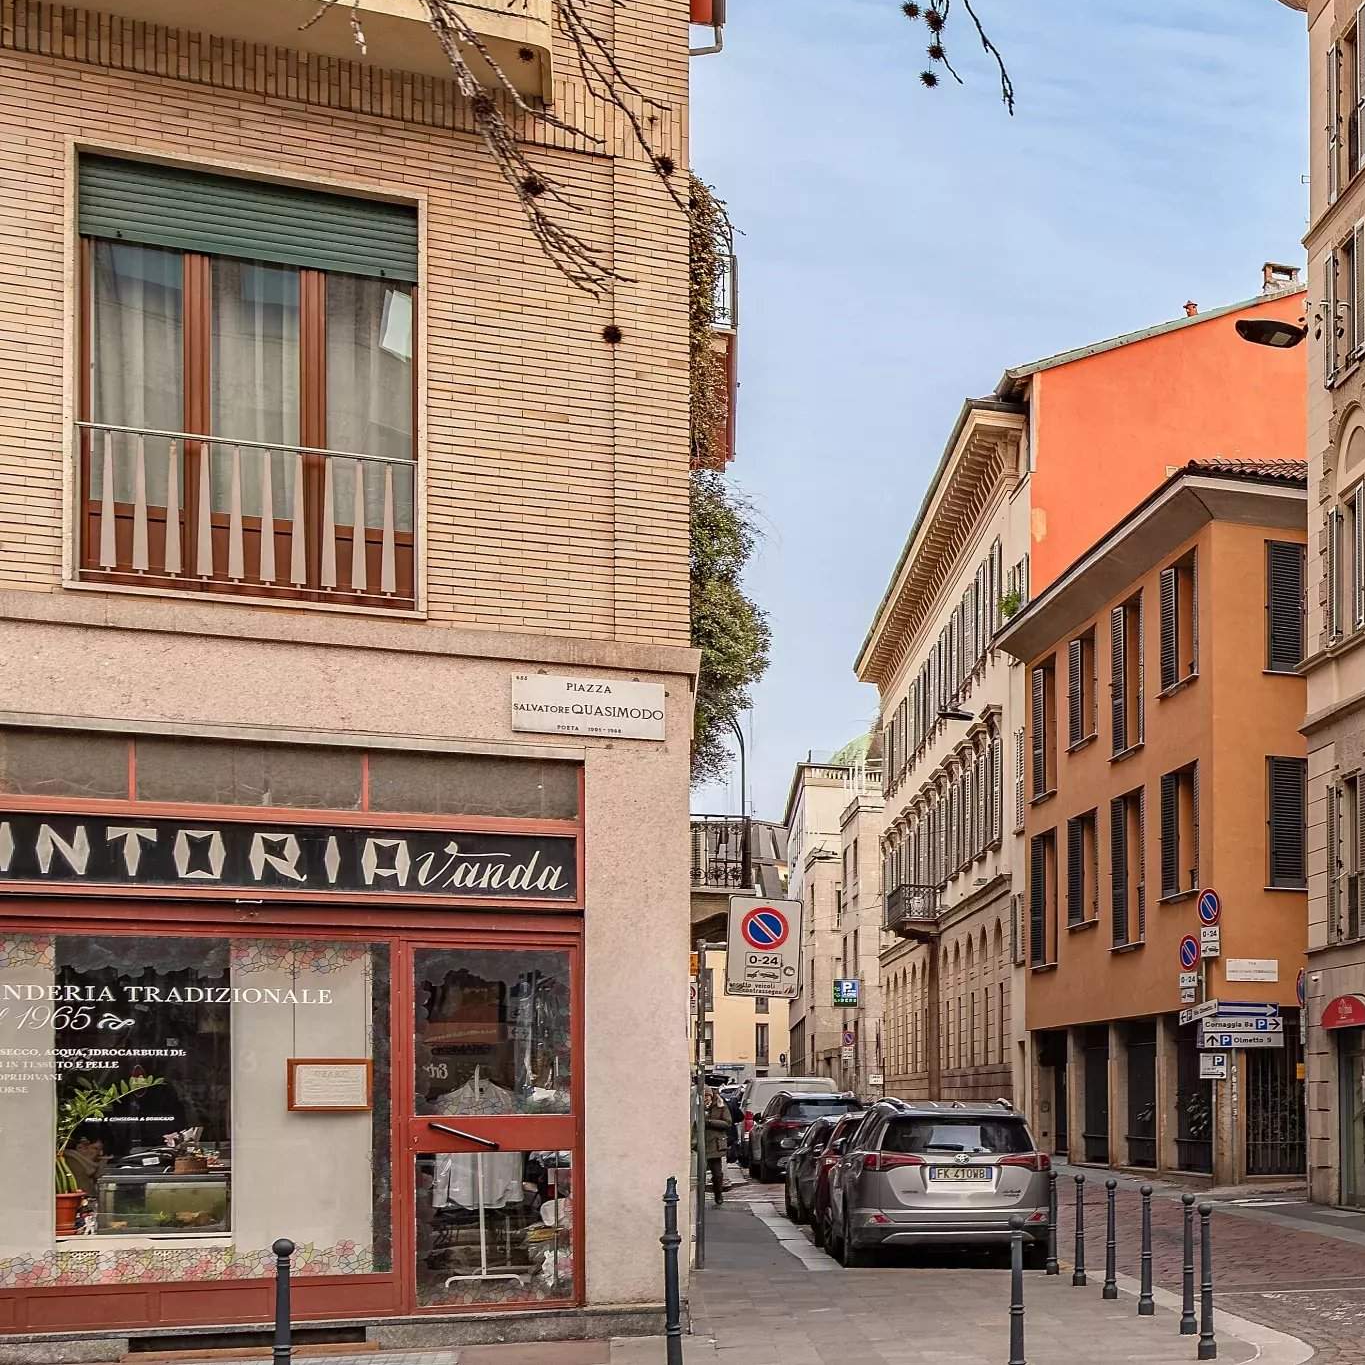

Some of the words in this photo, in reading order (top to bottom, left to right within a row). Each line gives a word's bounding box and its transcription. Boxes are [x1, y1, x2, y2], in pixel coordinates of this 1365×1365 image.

[566, 682, 612, 694] PIAZZA
[513, 702, 570, 714] SALVATORE
[571, 703, 664, 721] QUASIMODO
[416, 841, 570, 891] Vanda
[749, 955, 779, 966] 0-24
[1181, 975, 1195, 983] 0-24
[123, 985, 334, 1005] TRADIZIONALE
[15, 1005, 97, 1031] 1965
[1205, 1021, 1242, 1029] Cornaggia
[1257, 1020, 1266, 1029] P
[1222, 1036, 1231, 1045] P
[1234, 1035, 1263, 1043] Olmetto
[88, 1048, 169, 1057] IDROCARBURI
[74, 1061, 84, 1069] E
[85, 1061, 120, 1069] PELLE
